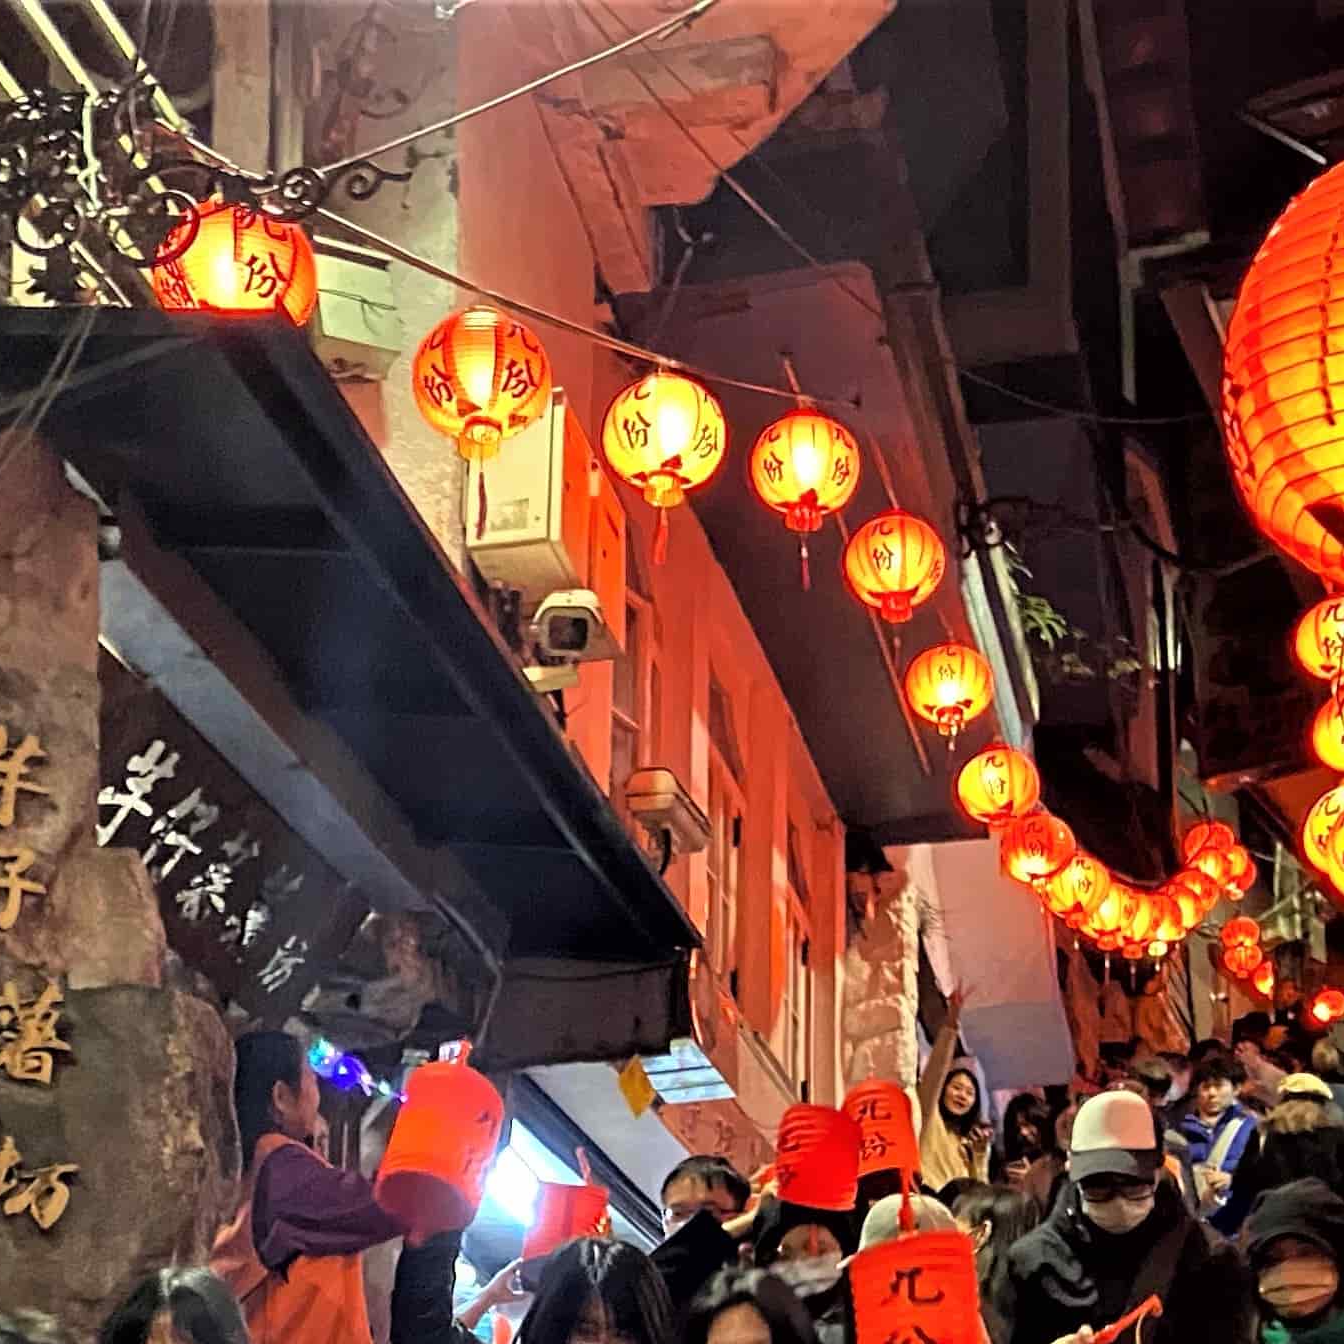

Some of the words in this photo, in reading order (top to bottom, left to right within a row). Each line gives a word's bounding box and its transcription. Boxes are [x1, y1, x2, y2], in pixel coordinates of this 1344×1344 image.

[502, 324, 538, 398] 九份
[623, 384, 651, 449] 九份
[758, 428, 784, 482] 九份
[872, 522, 894, 570] 九份
